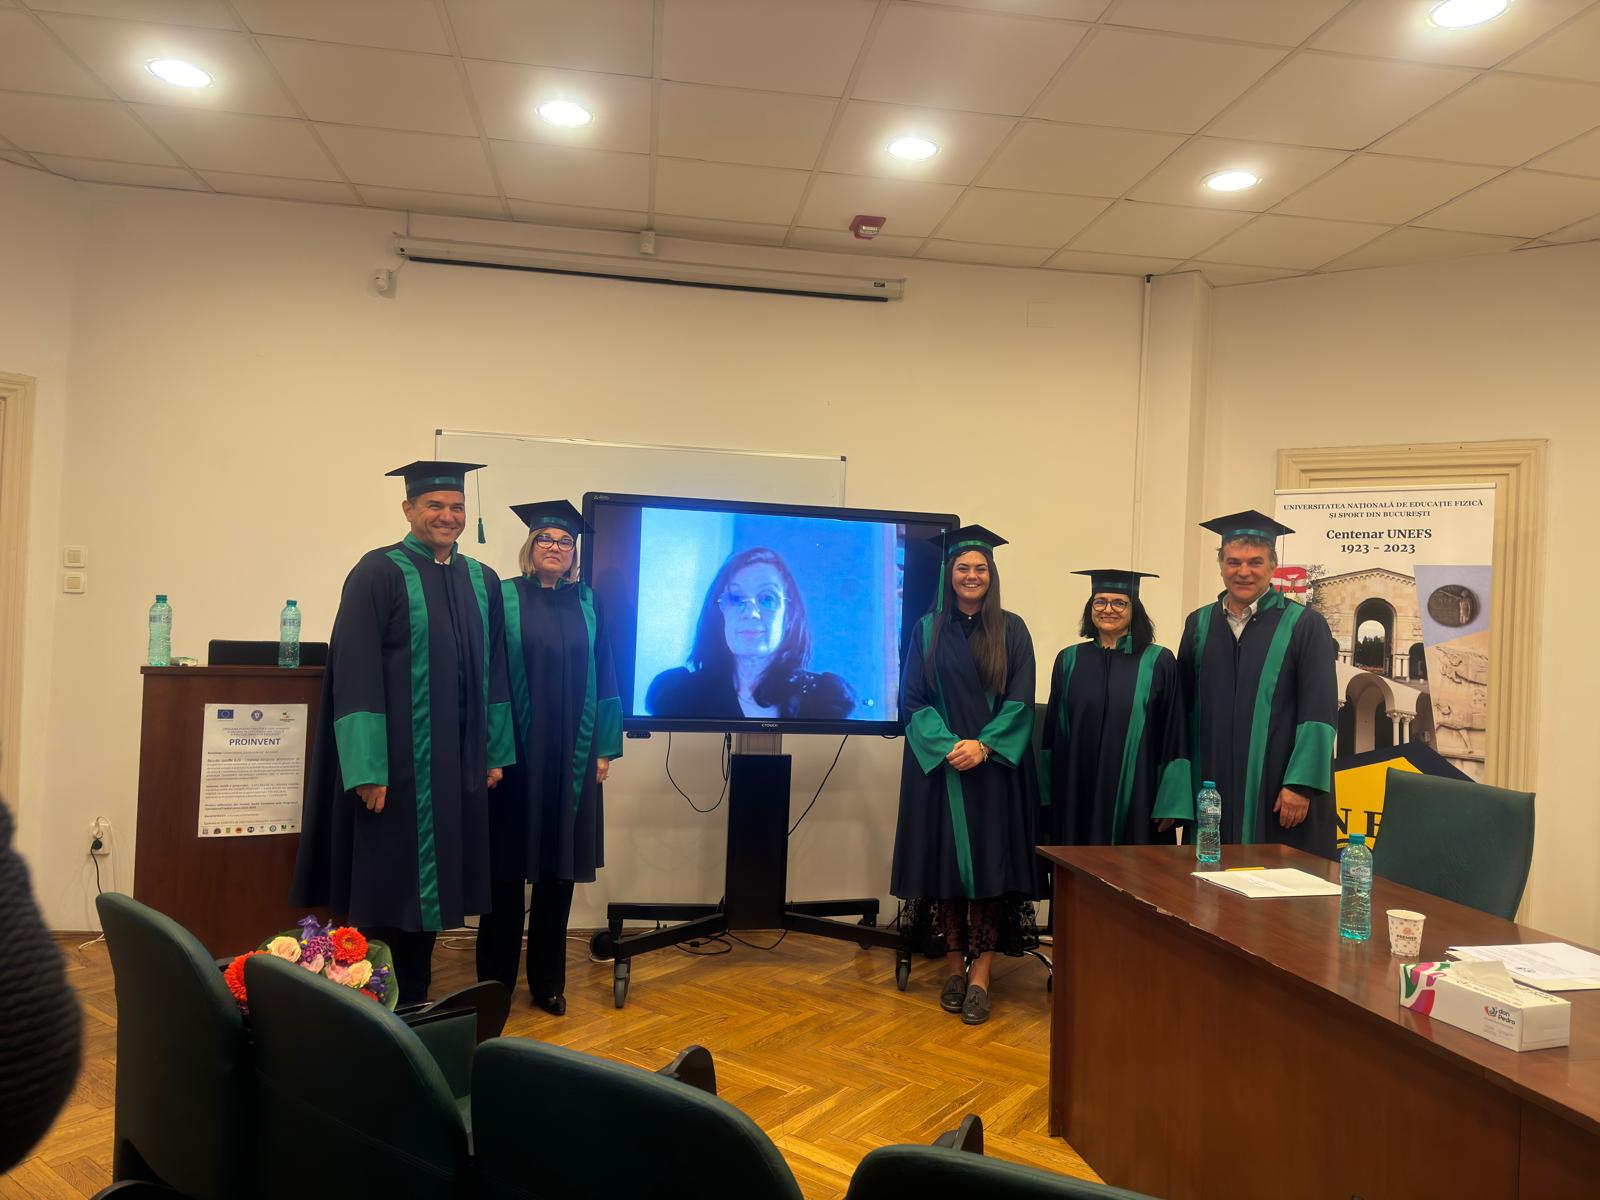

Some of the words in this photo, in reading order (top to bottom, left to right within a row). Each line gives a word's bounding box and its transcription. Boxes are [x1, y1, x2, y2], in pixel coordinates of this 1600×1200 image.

[1283, 503, 1346, 511] UNIVERSITATEA
[1326, 529, 1385, 540] Centenar
[1387, 528, 1432, 539] UNEFS
[1340, 543, 1370, 554] 1923
[1384, 543, 1416, 553] 2023
[229, 738, 281, 746] PROINVENT
